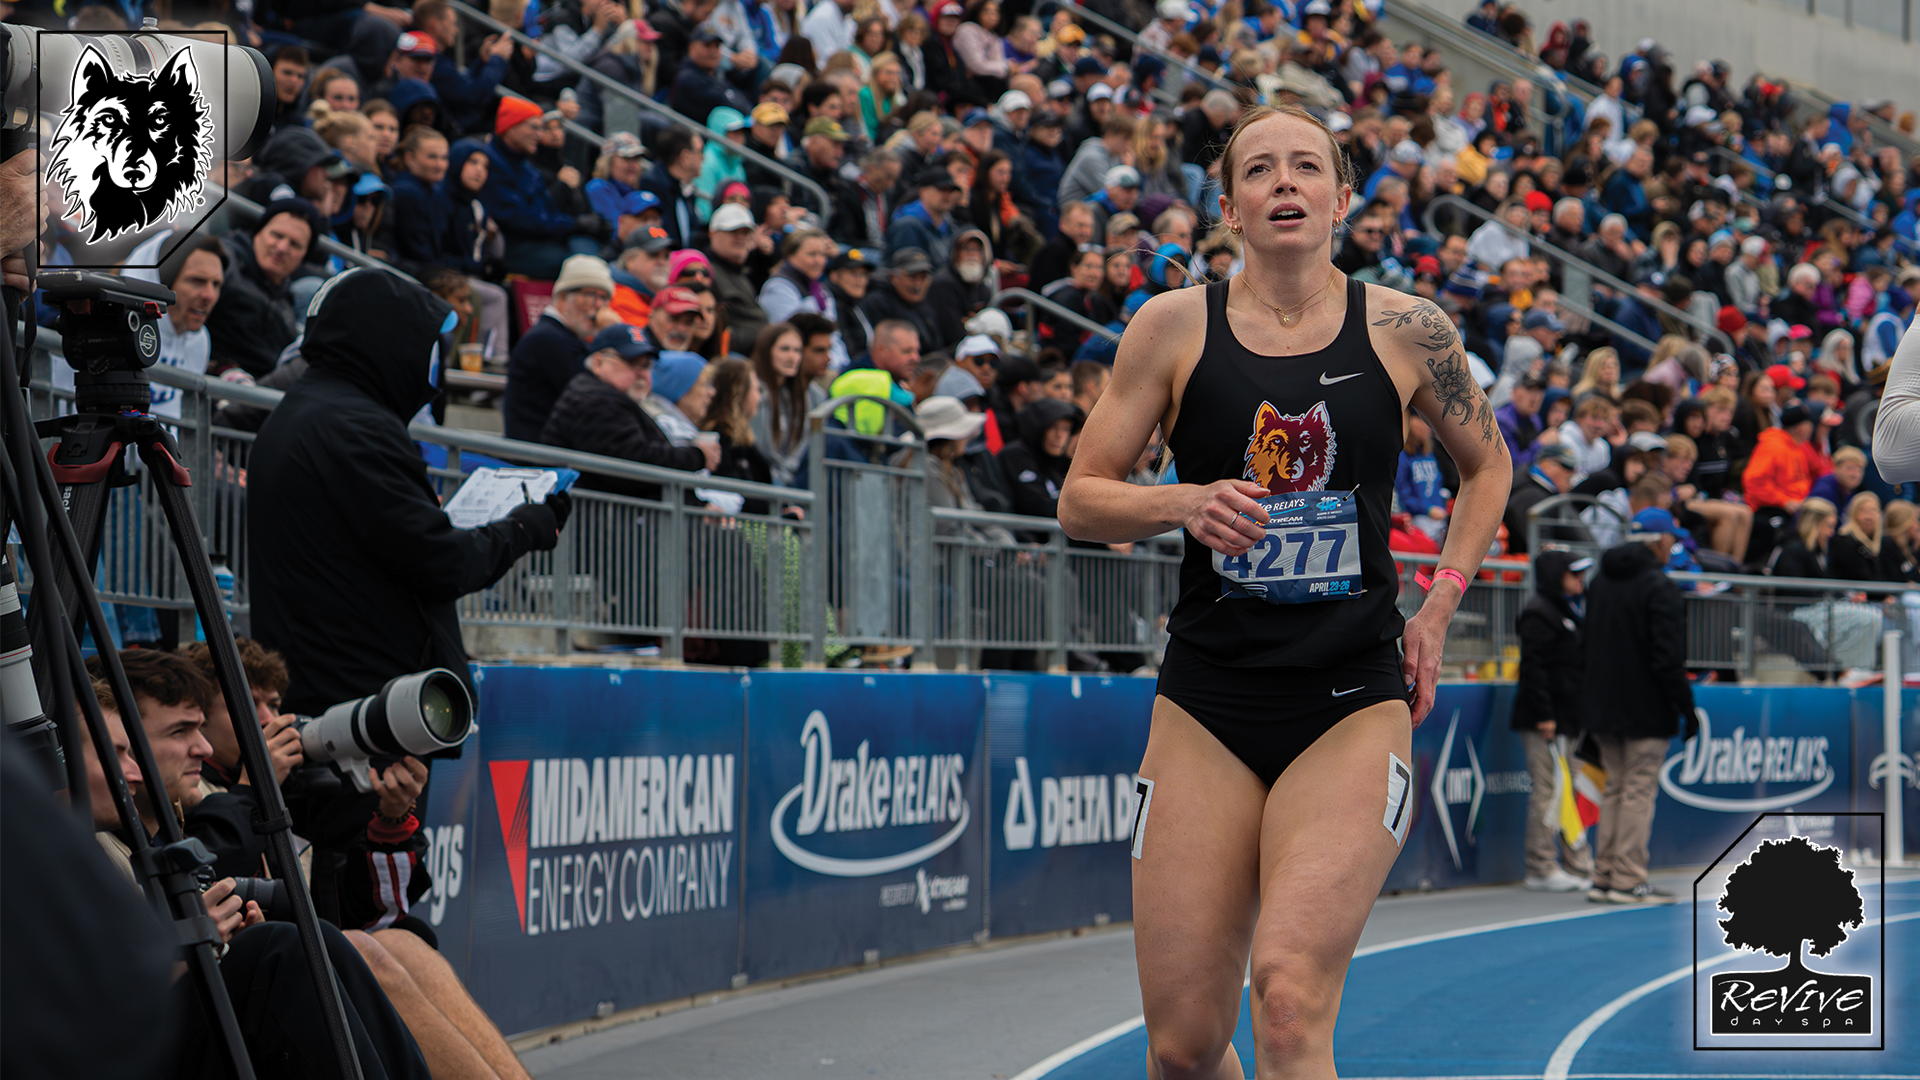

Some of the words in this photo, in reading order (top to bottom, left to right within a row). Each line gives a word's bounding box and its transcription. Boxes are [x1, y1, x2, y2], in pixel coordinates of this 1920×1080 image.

[1273, 498, 1305, 511] RELAYS
[1223, 529, 1347, 579] 4277
[1309, 581, 1329, 593] APRIL
[796, 710, 892, 835] Drake
[891, 753, 965, 827] RELAYS
[1679, 706, 1763, 785] Drake
[1762, 735, 1830, 782] RELAYS
[530, 753, 735, 848] MIDAMERICAN
[1041, 774, 1112, 847] DELTA
[1114, 772, 1138, 842] D
[1132, 781, 1149, 851] 7
[1391, 762, 1410, 832] 7
[527, 850, 618, 936] ENERGY
[619, 840, 733, 921] COMPANY
